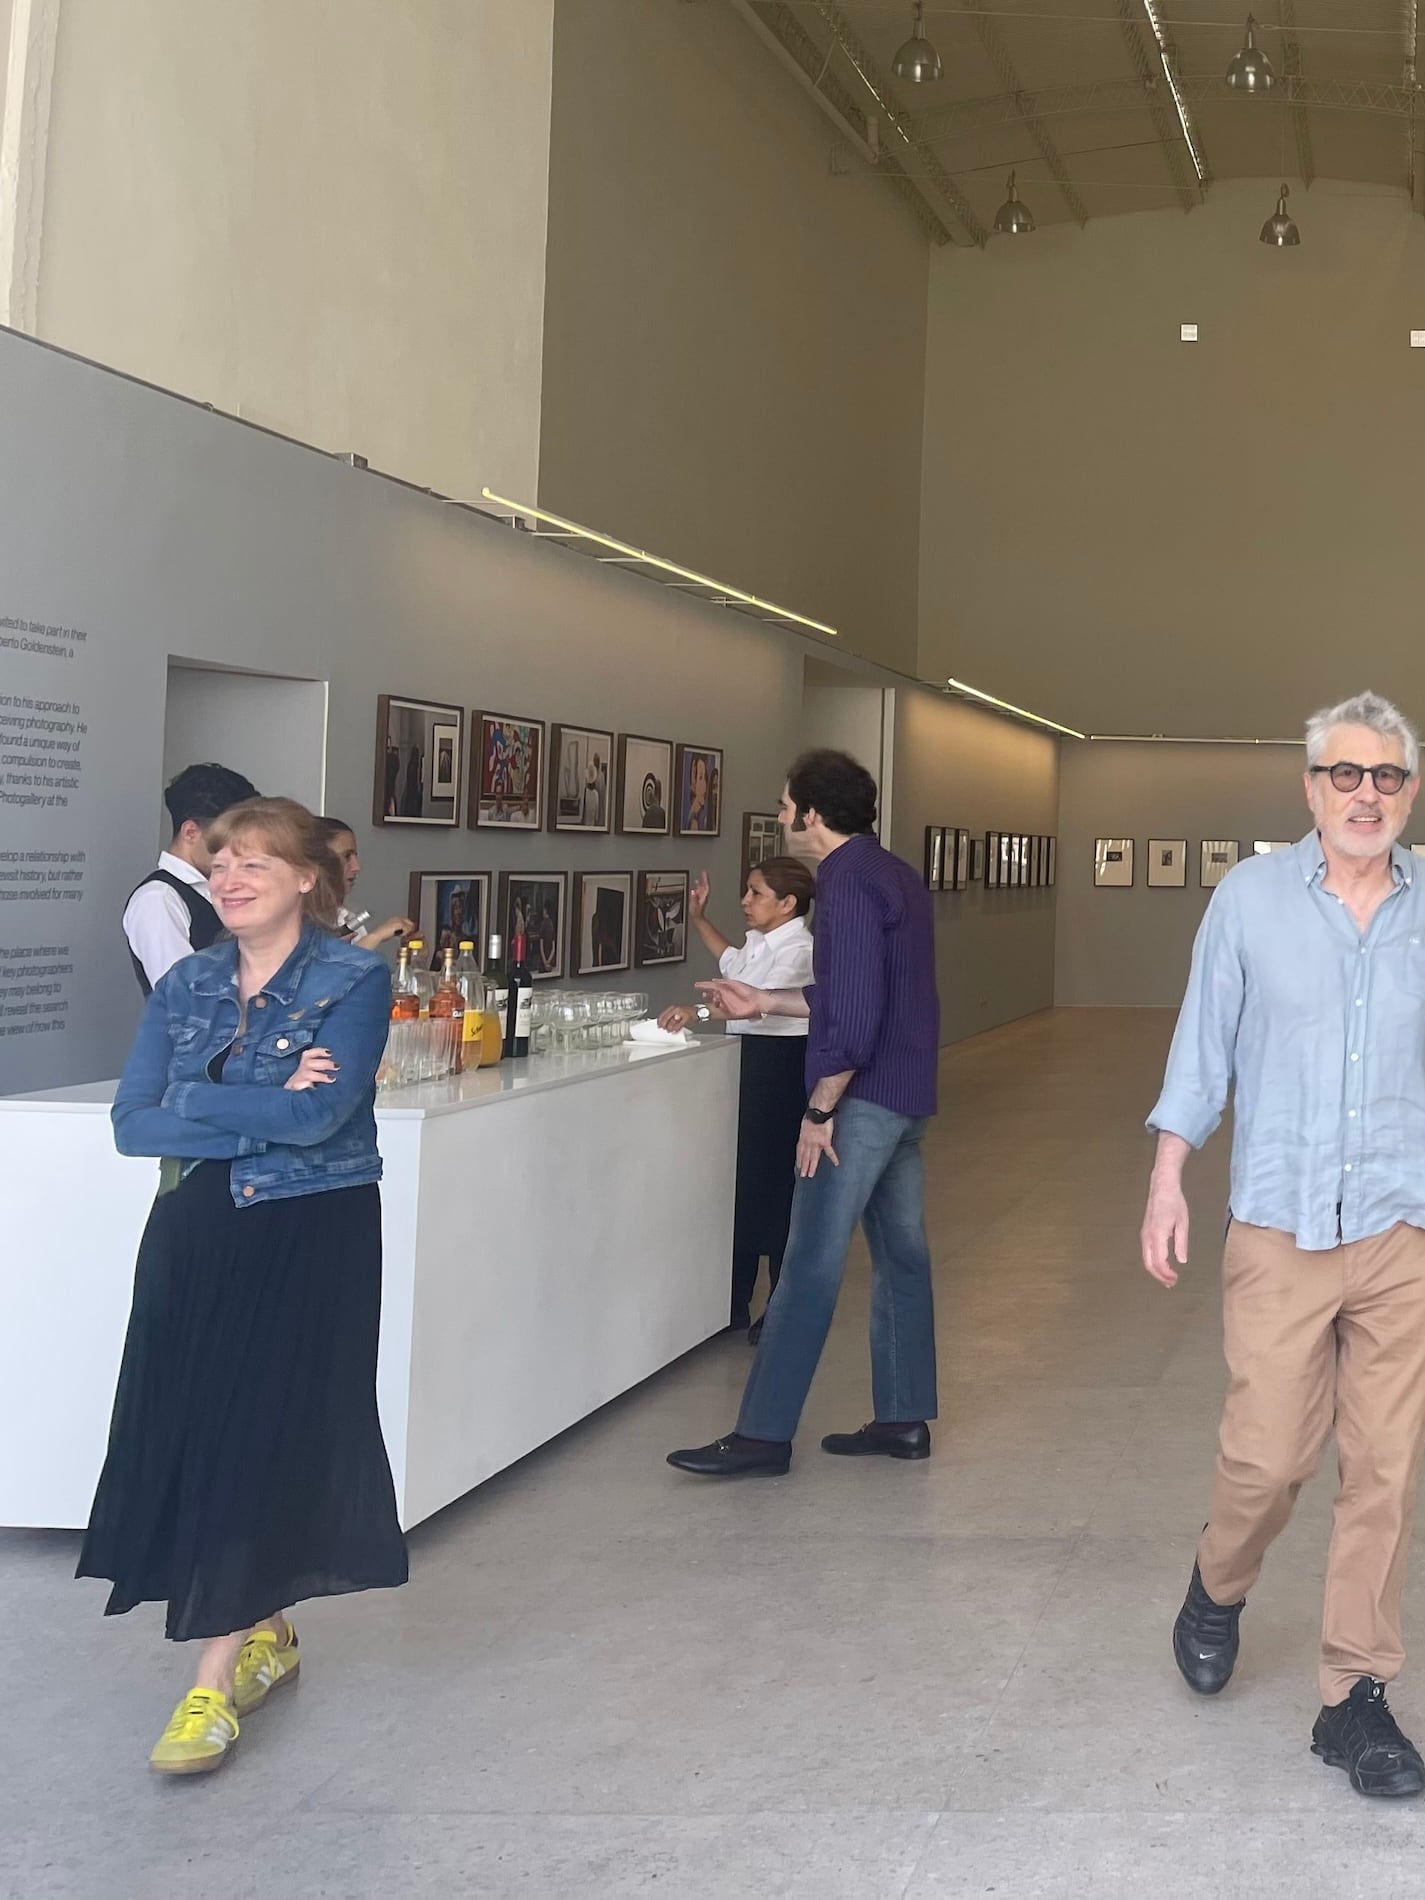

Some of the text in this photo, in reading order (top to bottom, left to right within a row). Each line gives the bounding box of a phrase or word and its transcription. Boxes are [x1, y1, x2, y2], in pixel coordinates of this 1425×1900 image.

[46, 624, 62, 637] part
[22, 696, 33, 709] his
[35, 700, 70, 713] approach
[77, 721, 88, 734] He
[30, 738, 55, 750] unique
[57, 741, 72, 752] way
[2, 754, 46, 767] compulsion
[6, 772, 32, 786] thanks
[43, 776, 53, 787] his
[55, 777, 79, 788] artistic
[56, 794, 68, 807] the
[26, 850, 69, 864] relationship
[70, 850, 86, 862] with
[48, 869, 60, 880] but
[52, 888, 62, 900] for
